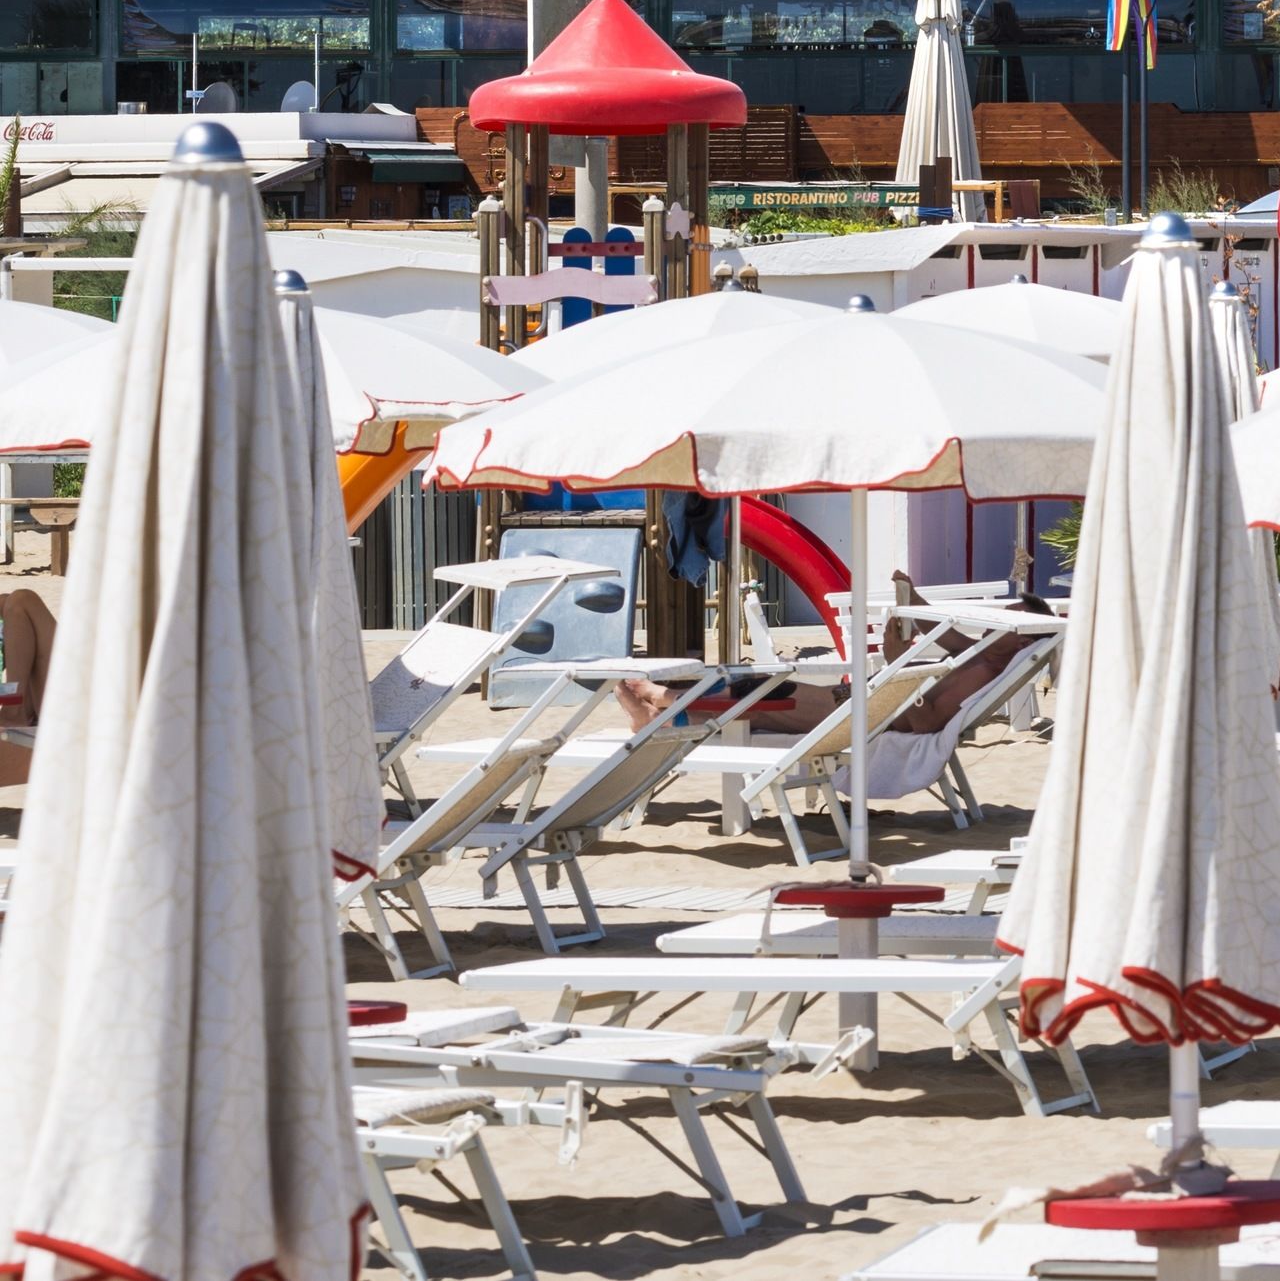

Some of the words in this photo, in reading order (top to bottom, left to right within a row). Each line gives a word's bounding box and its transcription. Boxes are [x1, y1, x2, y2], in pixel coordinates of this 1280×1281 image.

[4, 122, 55, 141] Coa-Cola
[709, 194, 745, 209] arge
[753, 192, 848, 205] RISTORANTINO
[853, 193, 879, 204] PUB
